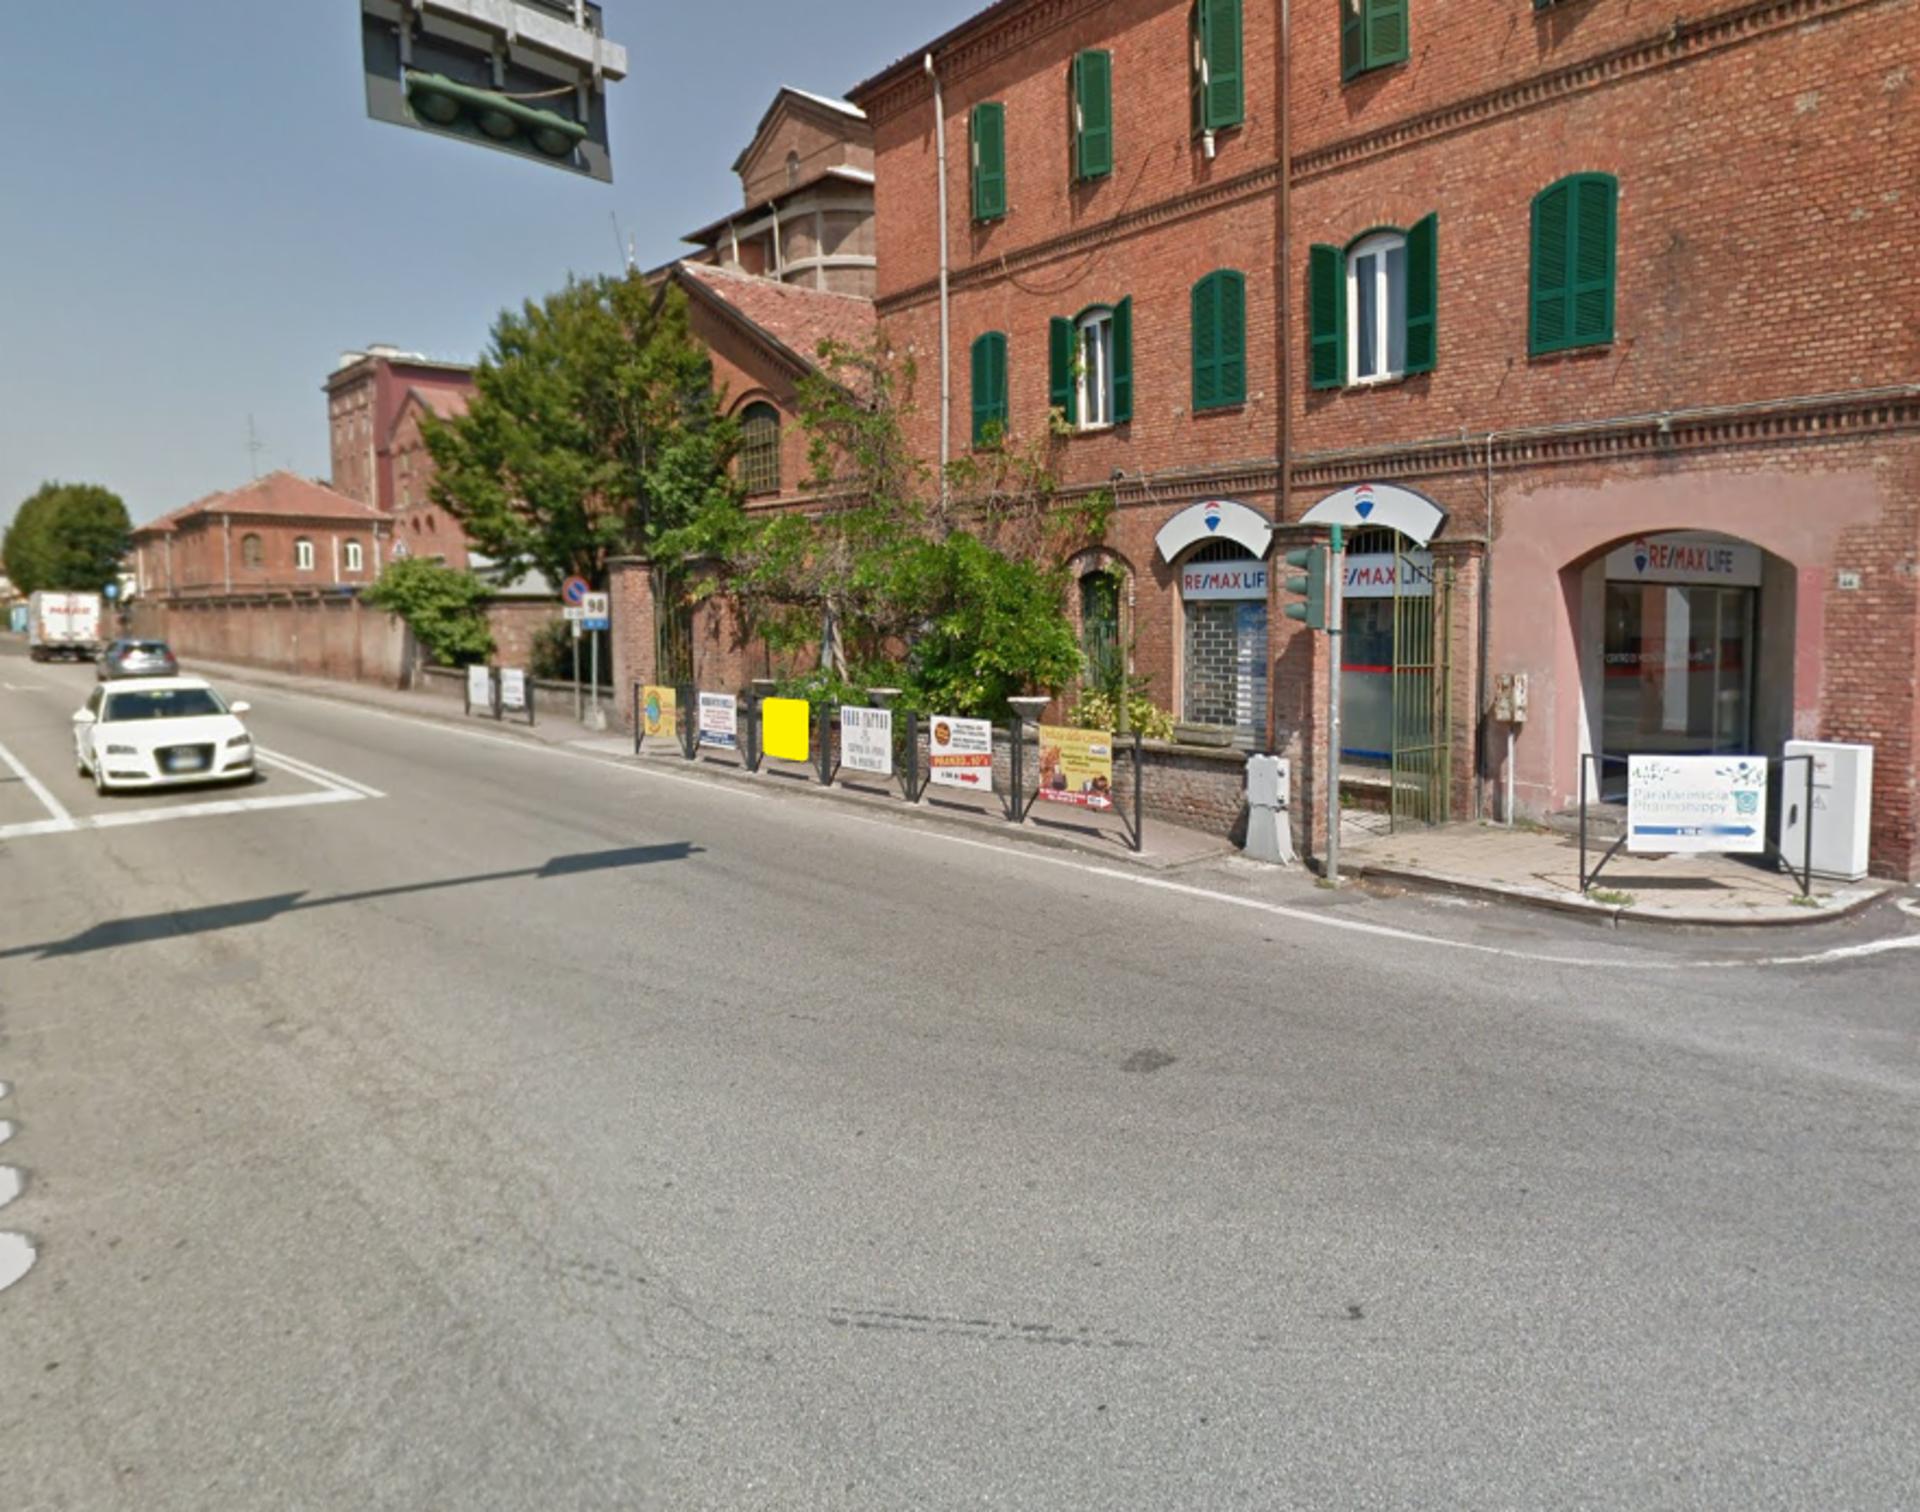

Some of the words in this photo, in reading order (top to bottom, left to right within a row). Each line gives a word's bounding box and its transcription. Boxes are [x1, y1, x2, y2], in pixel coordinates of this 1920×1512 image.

[1649, 544, 1706, 570] RE/MAX
[1707, 548, 1733, 573] LIFE
[1184, 572, 1241, 590] RE/MAX
[1243, 571, 1267, 589] LIF
